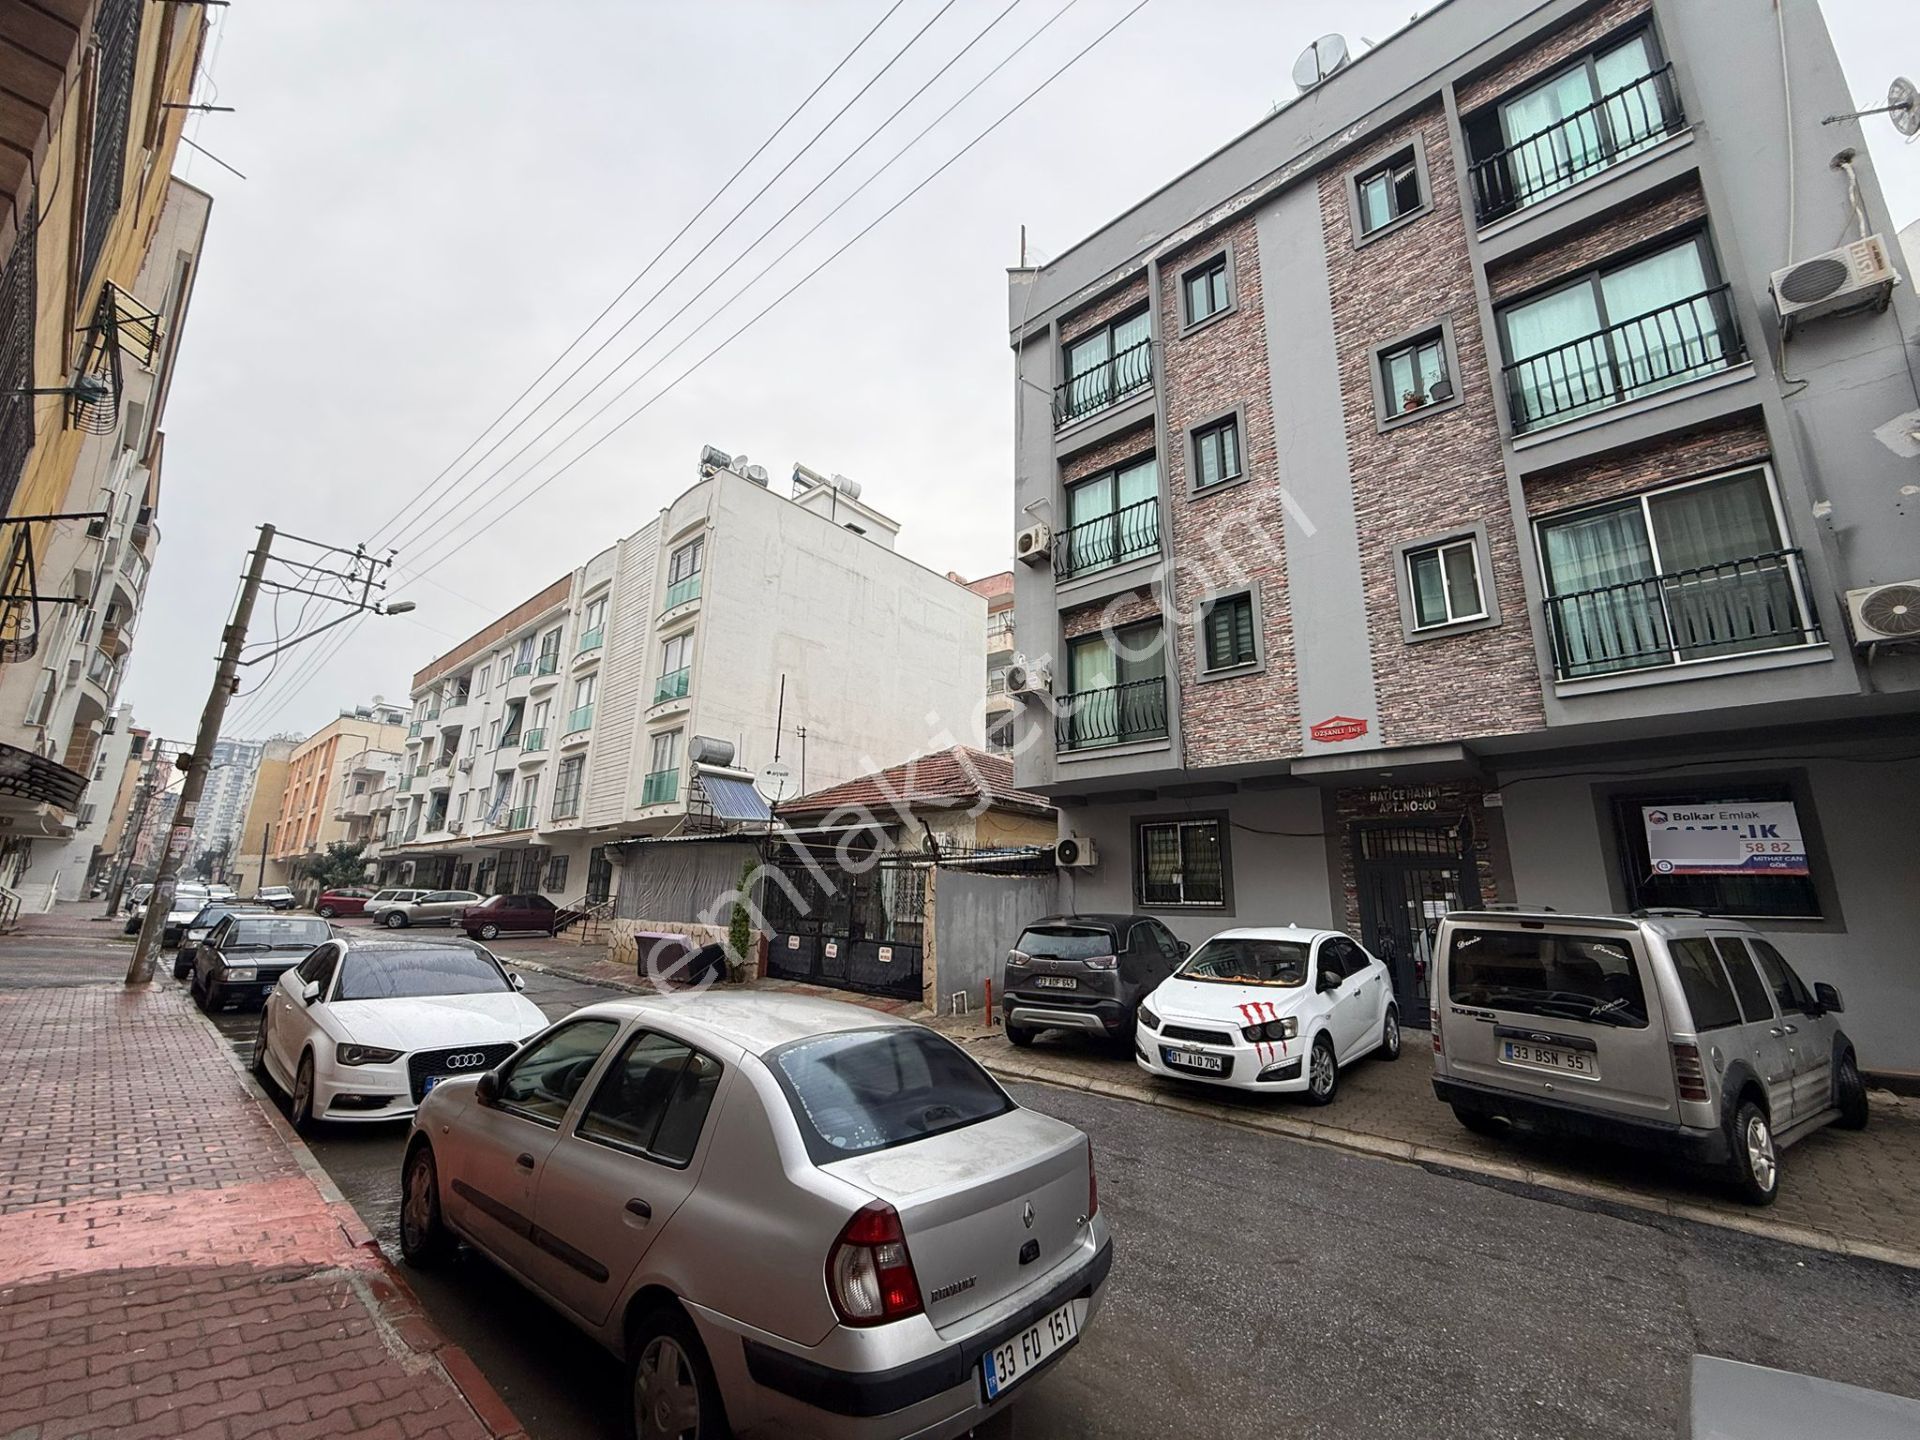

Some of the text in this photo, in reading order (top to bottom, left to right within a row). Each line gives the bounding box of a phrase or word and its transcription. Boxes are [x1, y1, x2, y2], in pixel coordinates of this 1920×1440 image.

[1673, 811, 1760, 821] Bolkar Emlak
[1745, 843, 1792, 853] 58 82
[1172, 1052, 1182, 1062] 01
[1188, 1055, 1203, 1066] AID
[1204, 1057, 1220, 1069] 704
[1513, 1046, 1584, 1069] 33 BSN 55
[996, 1307, 1072, 1383] 33 FD 151
